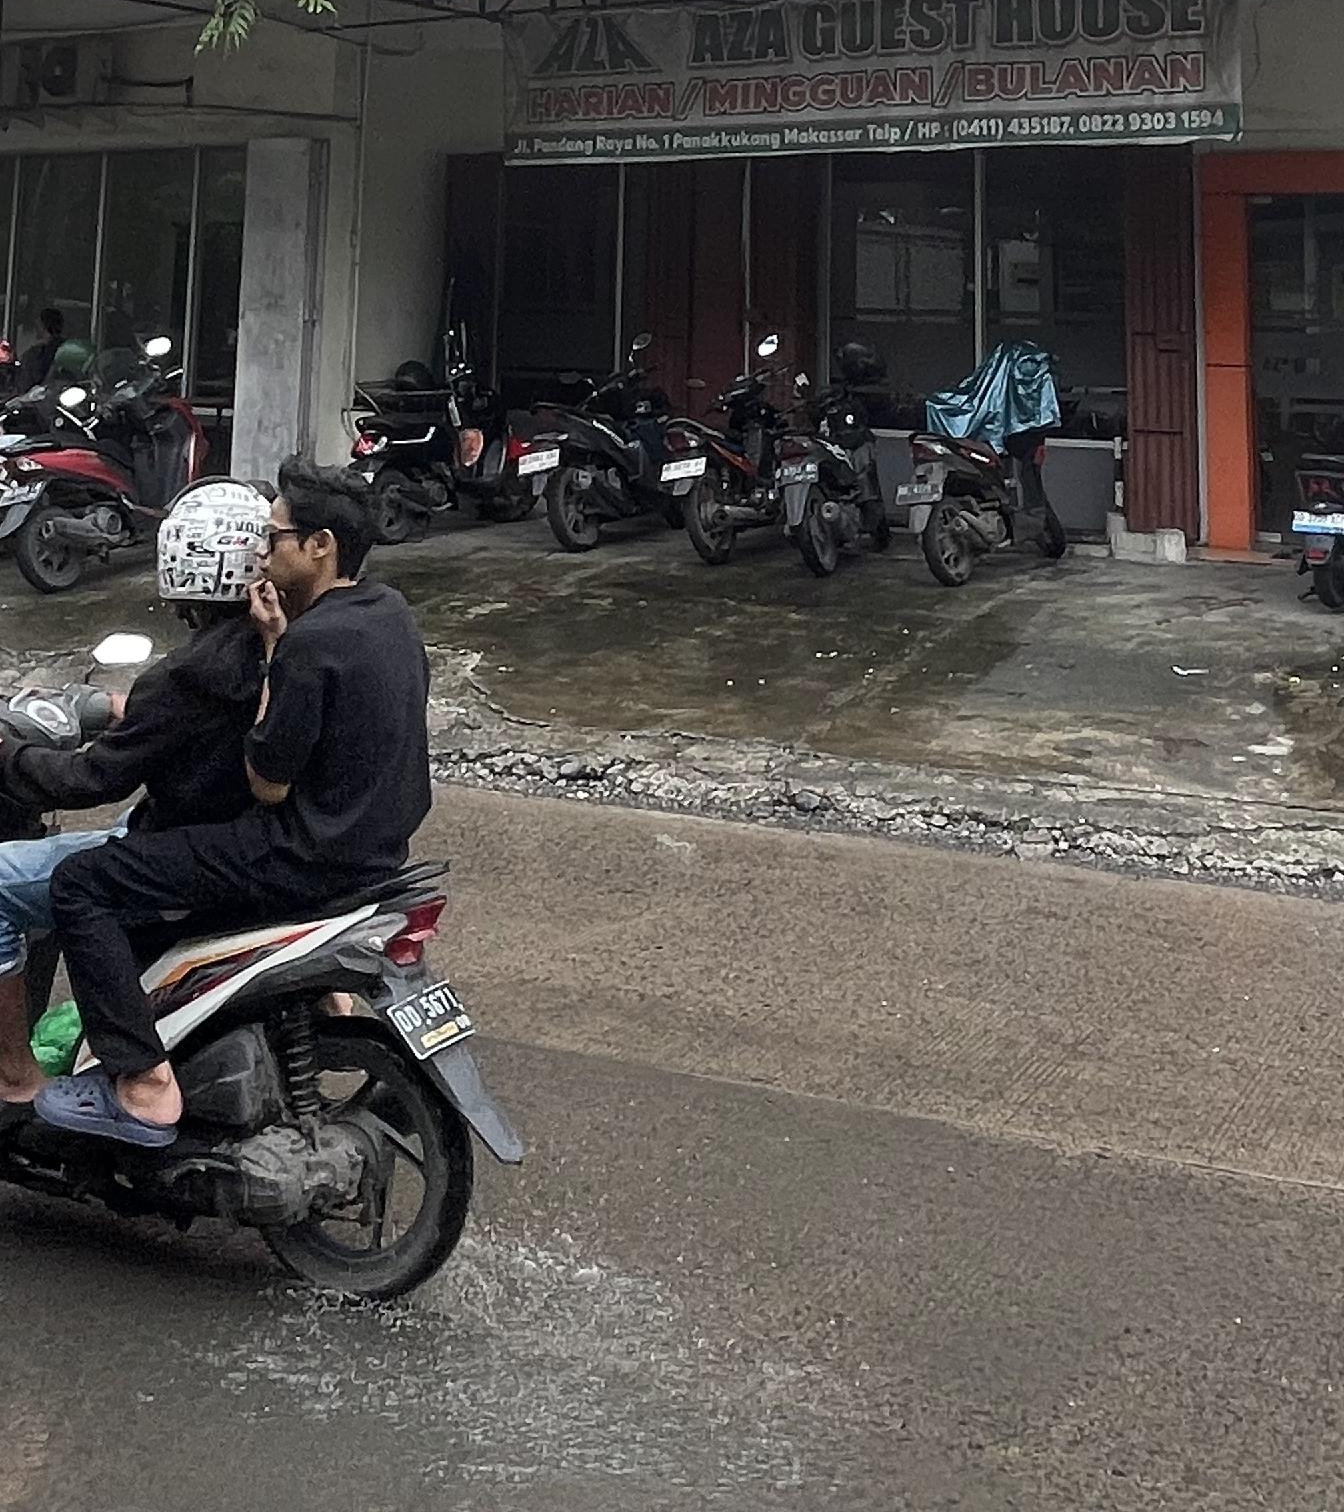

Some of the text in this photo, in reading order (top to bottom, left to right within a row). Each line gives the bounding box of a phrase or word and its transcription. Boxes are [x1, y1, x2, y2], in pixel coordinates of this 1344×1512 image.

[689, 10, 791, 67] AZA
[784, 126, 863, 145] Makassar
[953, 118, 1004, 141] (0411)
[1181, 109, 1224, 129] 1594
